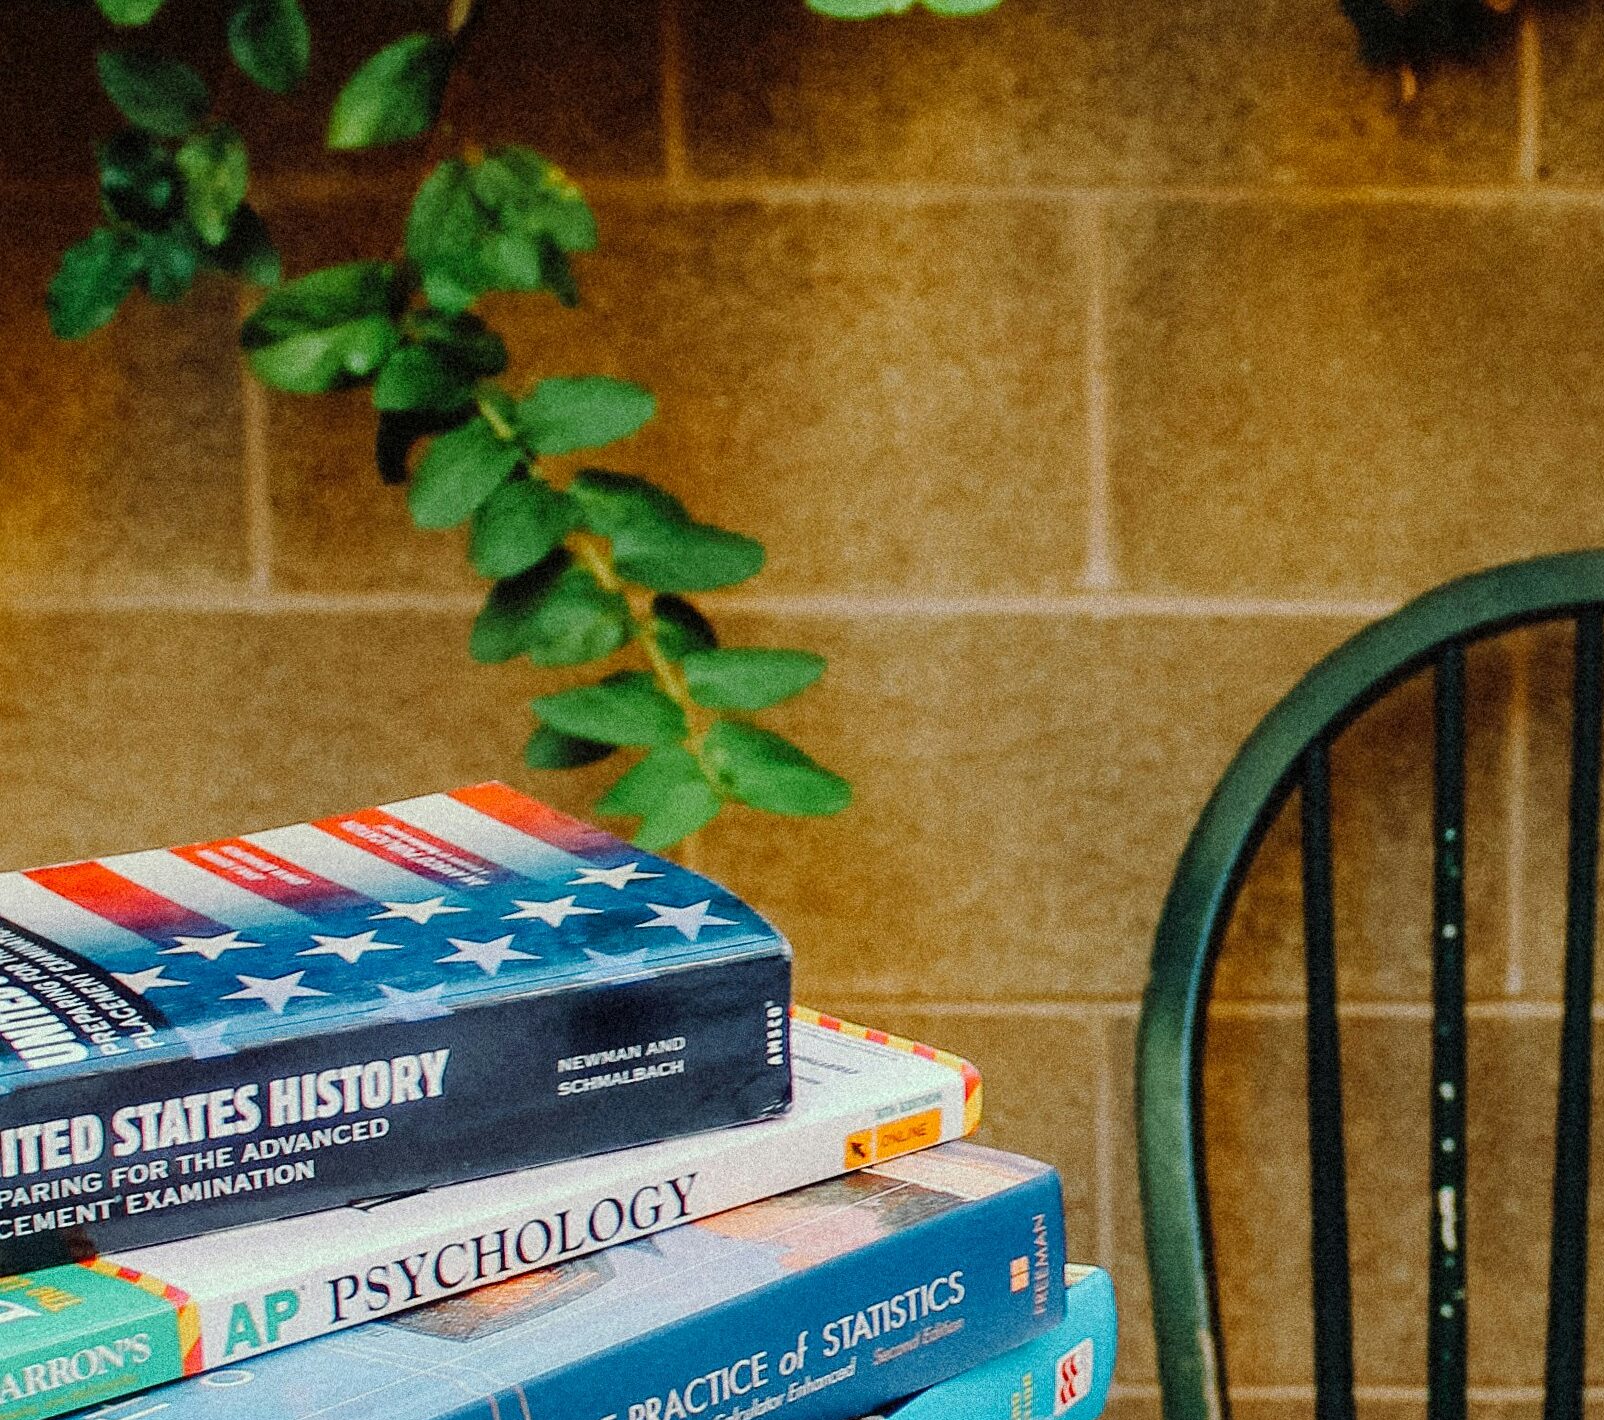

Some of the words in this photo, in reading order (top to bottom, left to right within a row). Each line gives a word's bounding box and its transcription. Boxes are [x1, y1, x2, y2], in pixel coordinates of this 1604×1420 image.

[33, 981, 129, 1056] PREPARING
[557, 1044, 642, 1074] NEWMAN
[646, 1036, 686, 1057] AND
[111, 1084, 260, 1159] STATES
[268, 1048, 453, 1129] HISTORY
[557, 1059, 686, 1097] SCHMALBACH
[111, 1159, 169, 1189] FOR
[175, 1147, 235, 1174] THE
[241, 1117, 391, 1164] ADVANCED
[126, 1159, 316, 1217] EXAMINATION
[224, 1289, 300, 1358] AP
[327, 1173, 698, 1324] PSYCHOLOGY
[1032, 1213, 1049, 1316] FREEMAN
[778, 1331, 810, 1377] of
[822, 1270, 966, 1358] STATISTICS
[786, 1356, 857, 1404] Enhanced
